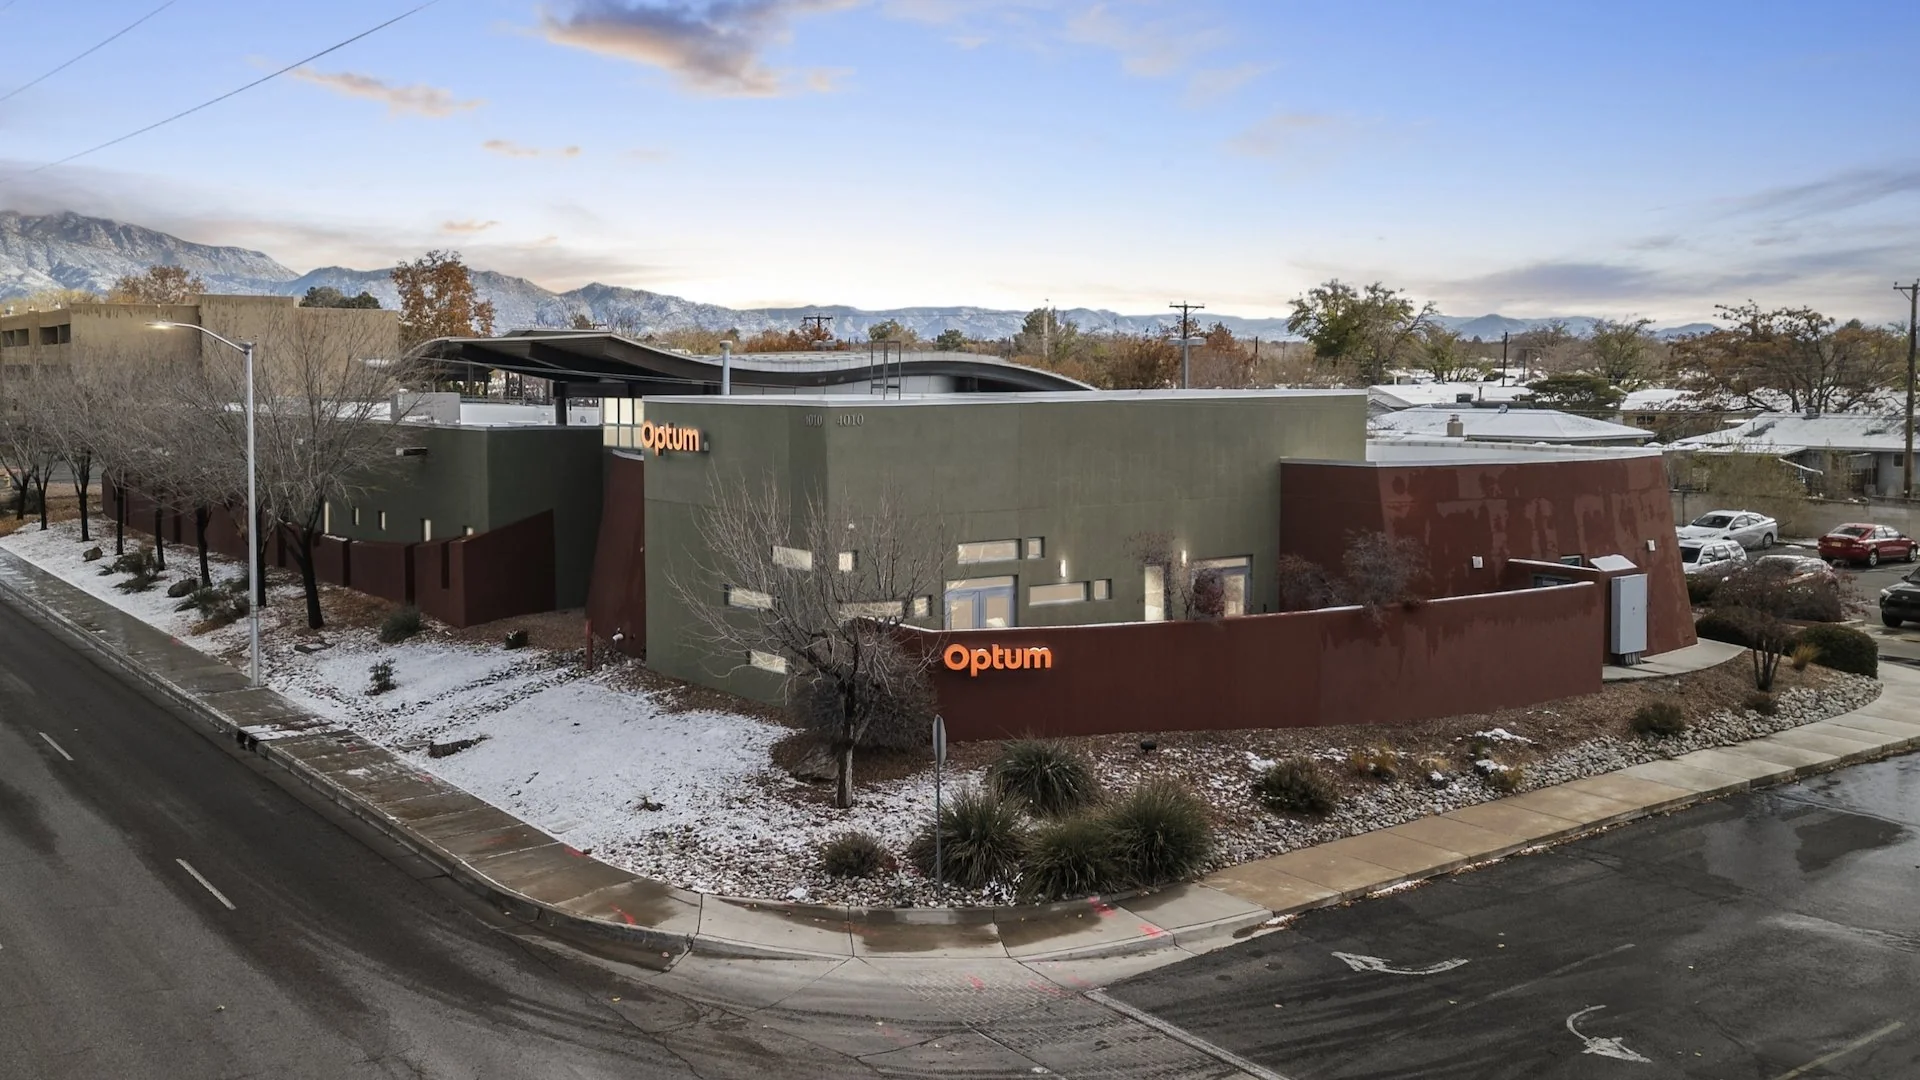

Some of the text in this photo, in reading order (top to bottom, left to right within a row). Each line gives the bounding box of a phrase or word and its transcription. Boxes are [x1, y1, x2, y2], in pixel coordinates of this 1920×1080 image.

[837, 413, 864, 426] 4010
[641, 420, 700, 456] Optum
[944, 643, 1052, 677] Optum
